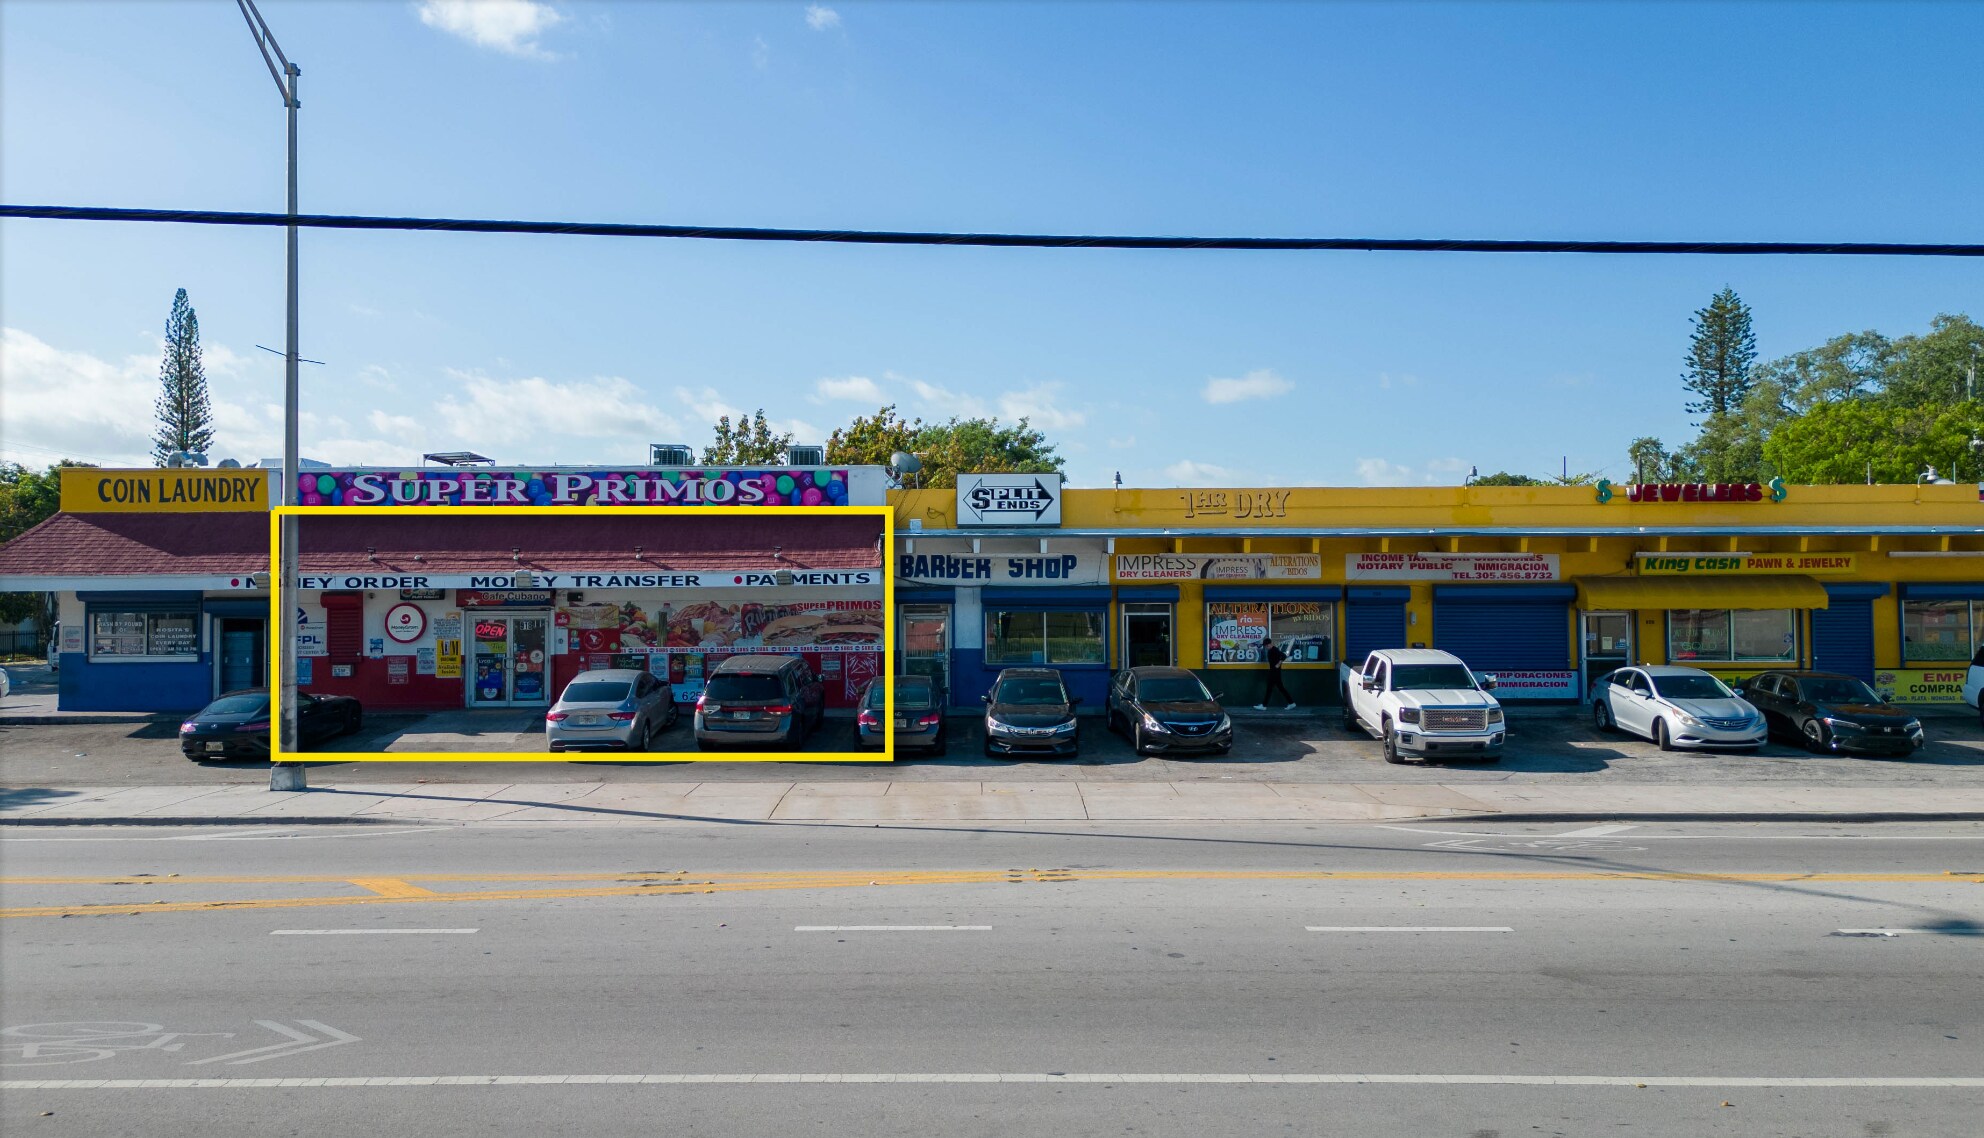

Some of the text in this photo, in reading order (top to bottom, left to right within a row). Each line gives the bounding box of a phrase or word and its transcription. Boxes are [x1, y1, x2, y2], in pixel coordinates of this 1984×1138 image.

[98, 477, 261, 503] COIN LAUNDRY
[353, 474, 766, 503] SUPER PRIMOS
[1596, 476, 1787, 504] $ JEWELERS $
[971, 487, 1042, 509] SPLIT
[1233, 490, 1291, 519] DRY
[996, 500, 1041, 510] ENDS
[1117, 555, 1197, 570] IMPRESS
[1270, 555, 1319, 568] ALTERATIONS
[1361, 554, 1404, 562] INCOME
[1407, 554, 1428, 562] TAX
[1644, 557, 1851, 571] King Cash PAWN & JEWELRY
[900, 554, 1078, 579] BARBER SHOP
[1215, 566, 1249, 574] IMPRESS
[1356, 562, 1549, 571] NOTARY PUBLIC INMIGRACION
[344, 576, 429, 588] ORDER
[471, 576, 558, 587] MOEY
[571, 575, 700, 587] TRANSFER
[746, 573, 871, 586] PAMENTS
[1119, 570, 1192, 578] DRY CLEANERS
[482, 591, 546, 600] Cafe Cubano
[797, 600, 882, 611] SUPER PRIMOS
[1240, 614, 1253, 623] ria
[475, 624, 505, 637] OPEN
[1215, 625, 1263, 635] IMPRESS
[1222, 649, 1260, 662] (786)
